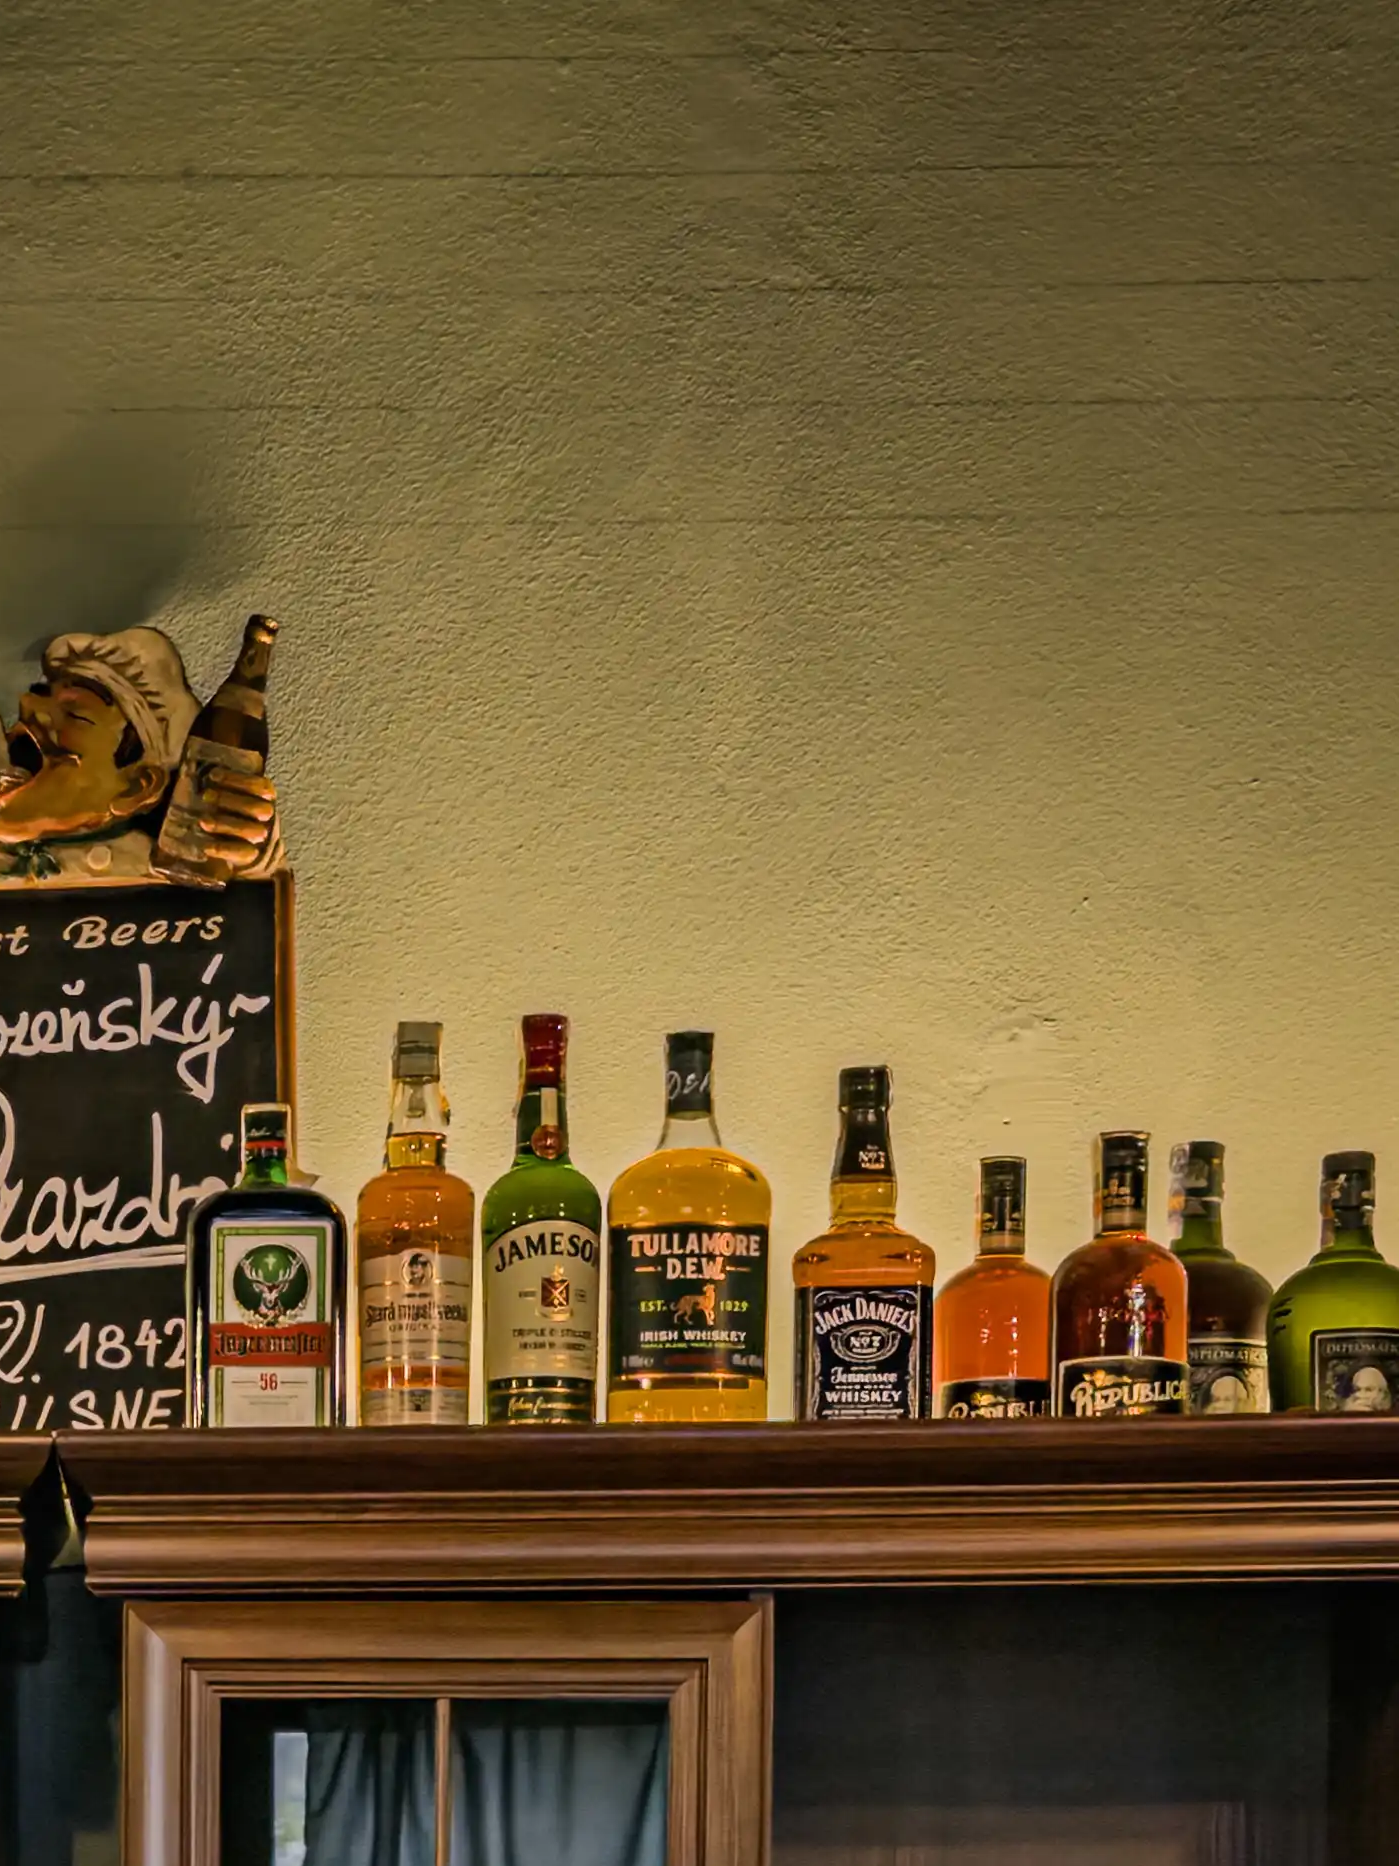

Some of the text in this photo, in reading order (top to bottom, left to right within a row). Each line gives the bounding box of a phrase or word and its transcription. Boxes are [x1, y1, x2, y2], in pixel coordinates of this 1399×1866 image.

[63, 915, 224, 949] Beers
[495, 1232, 597, 1273] JAMESO
[628, 1232, 761, 1257] TULLAMORE
[666, 1257, 726, 1280] D.E.W.
[815, 1303, 854, 1335] JACK
[64, 1318, 185, 1369] 1842
[640, 1331, 747, 1341] IRISH WHISKEY
[824, 1390, 902, 1403] WHISKEY
